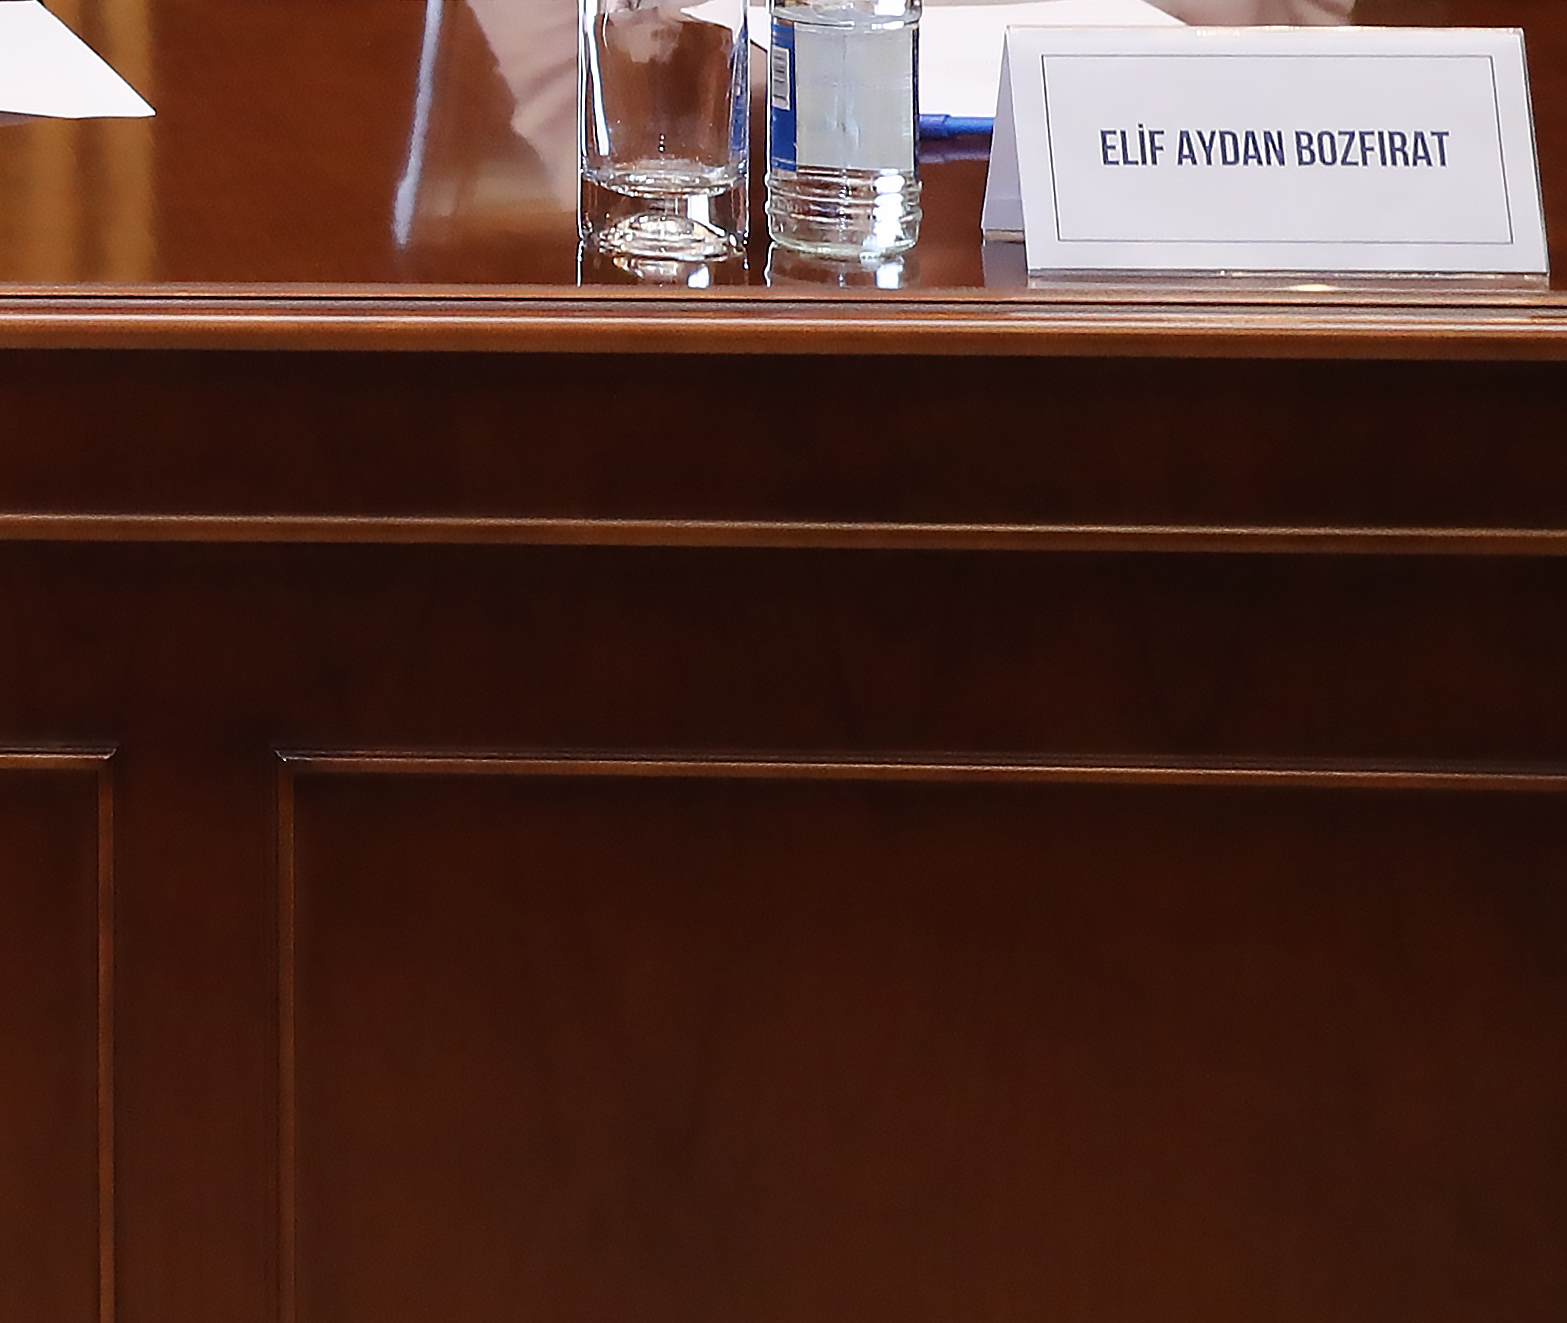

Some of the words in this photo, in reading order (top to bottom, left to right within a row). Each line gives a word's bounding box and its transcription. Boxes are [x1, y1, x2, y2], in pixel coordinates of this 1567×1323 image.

[1100, 123, 1165, 166] ELİF
[1177, 129, 1286, 167] AYDAN
[1294, 130, 1450, 167] BOZFIRAT
